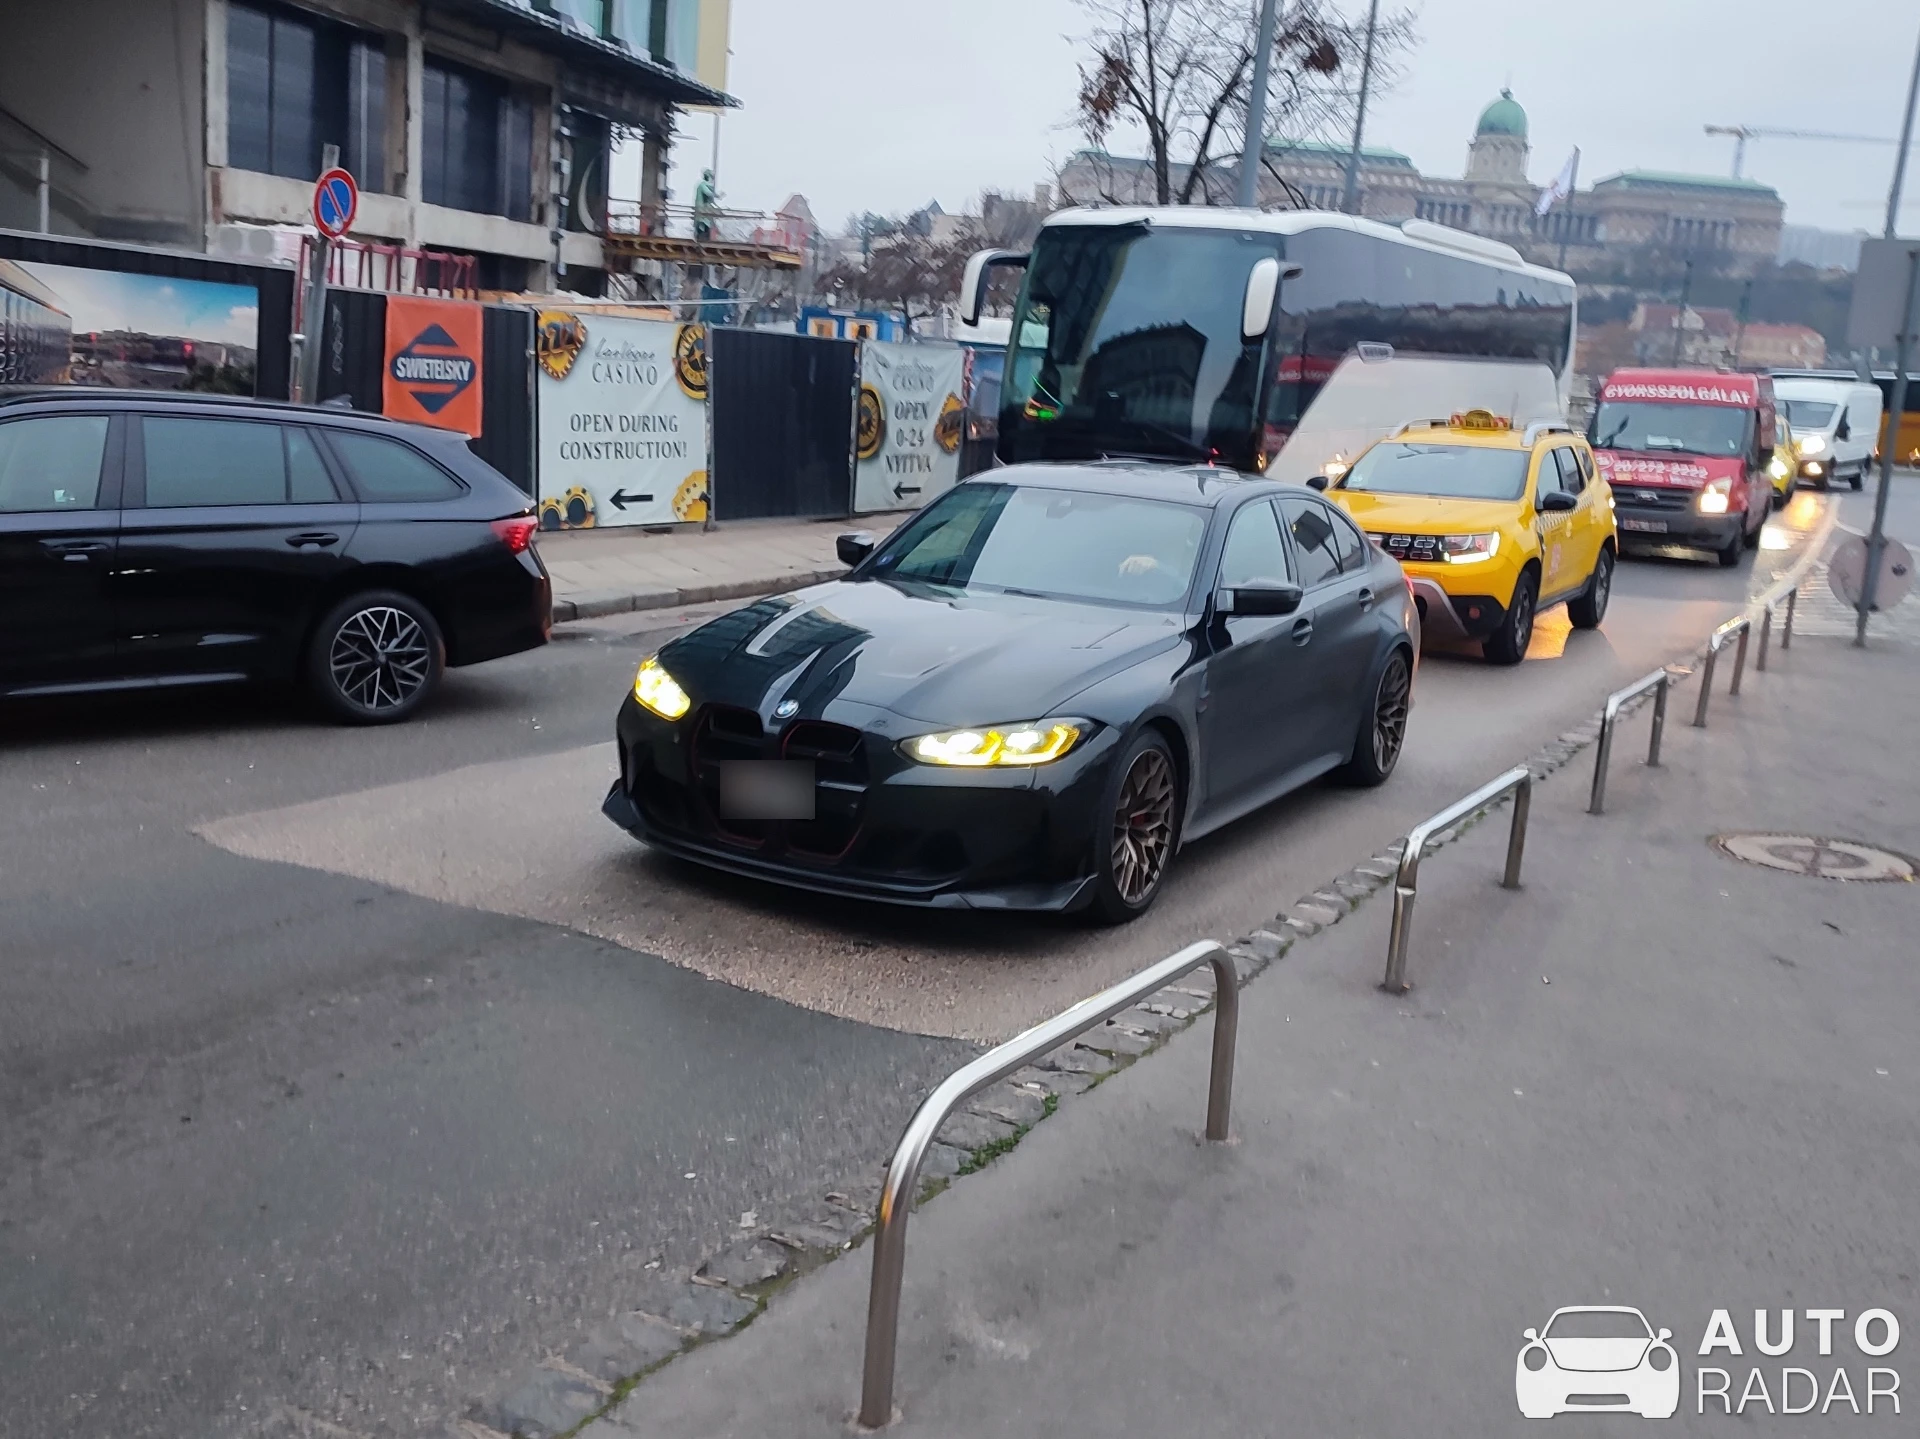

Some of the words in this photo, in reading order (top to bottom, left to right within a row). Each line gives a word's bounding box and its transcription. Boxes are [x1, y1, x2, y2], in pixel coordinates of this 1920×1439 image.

[395, 355, 471, 382] SWIETELSKY
[592, 361, 658, 386] CASINO
[895, 401, 929, 420] OPEN
[570, 413, 613, 433] OPEN
[619, 413, 679, 434] DURING
[895, 428, 925, 448] 0-24
[559, 440, 688, 460] CONSTRUCTION!
